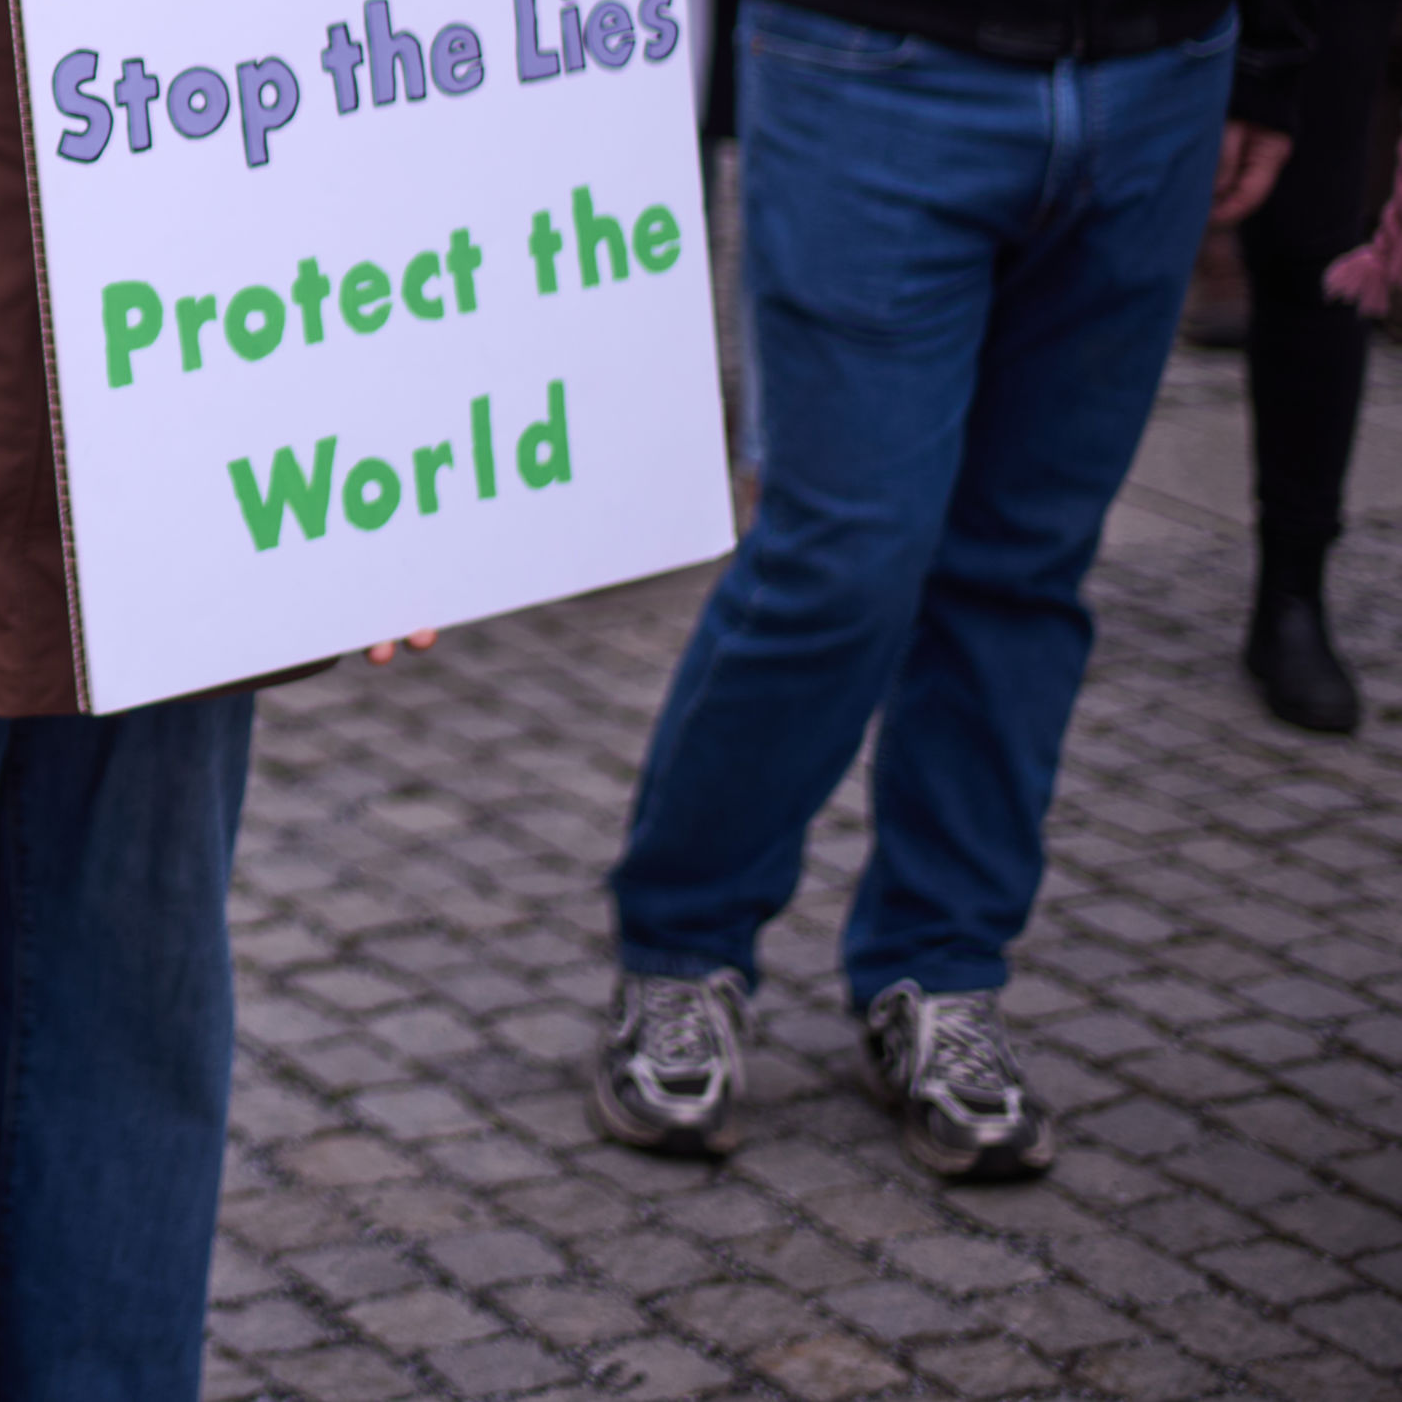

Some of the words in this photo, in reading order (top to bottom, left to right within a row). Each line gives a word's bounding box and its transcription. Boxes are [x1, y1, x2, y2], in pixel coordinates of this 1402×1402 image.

[51, 48, 300, 168] Stop
[101, 226, 482, 388] Protect
[528, 184, 681, 296] the
[227, 378, 572, 552] World
